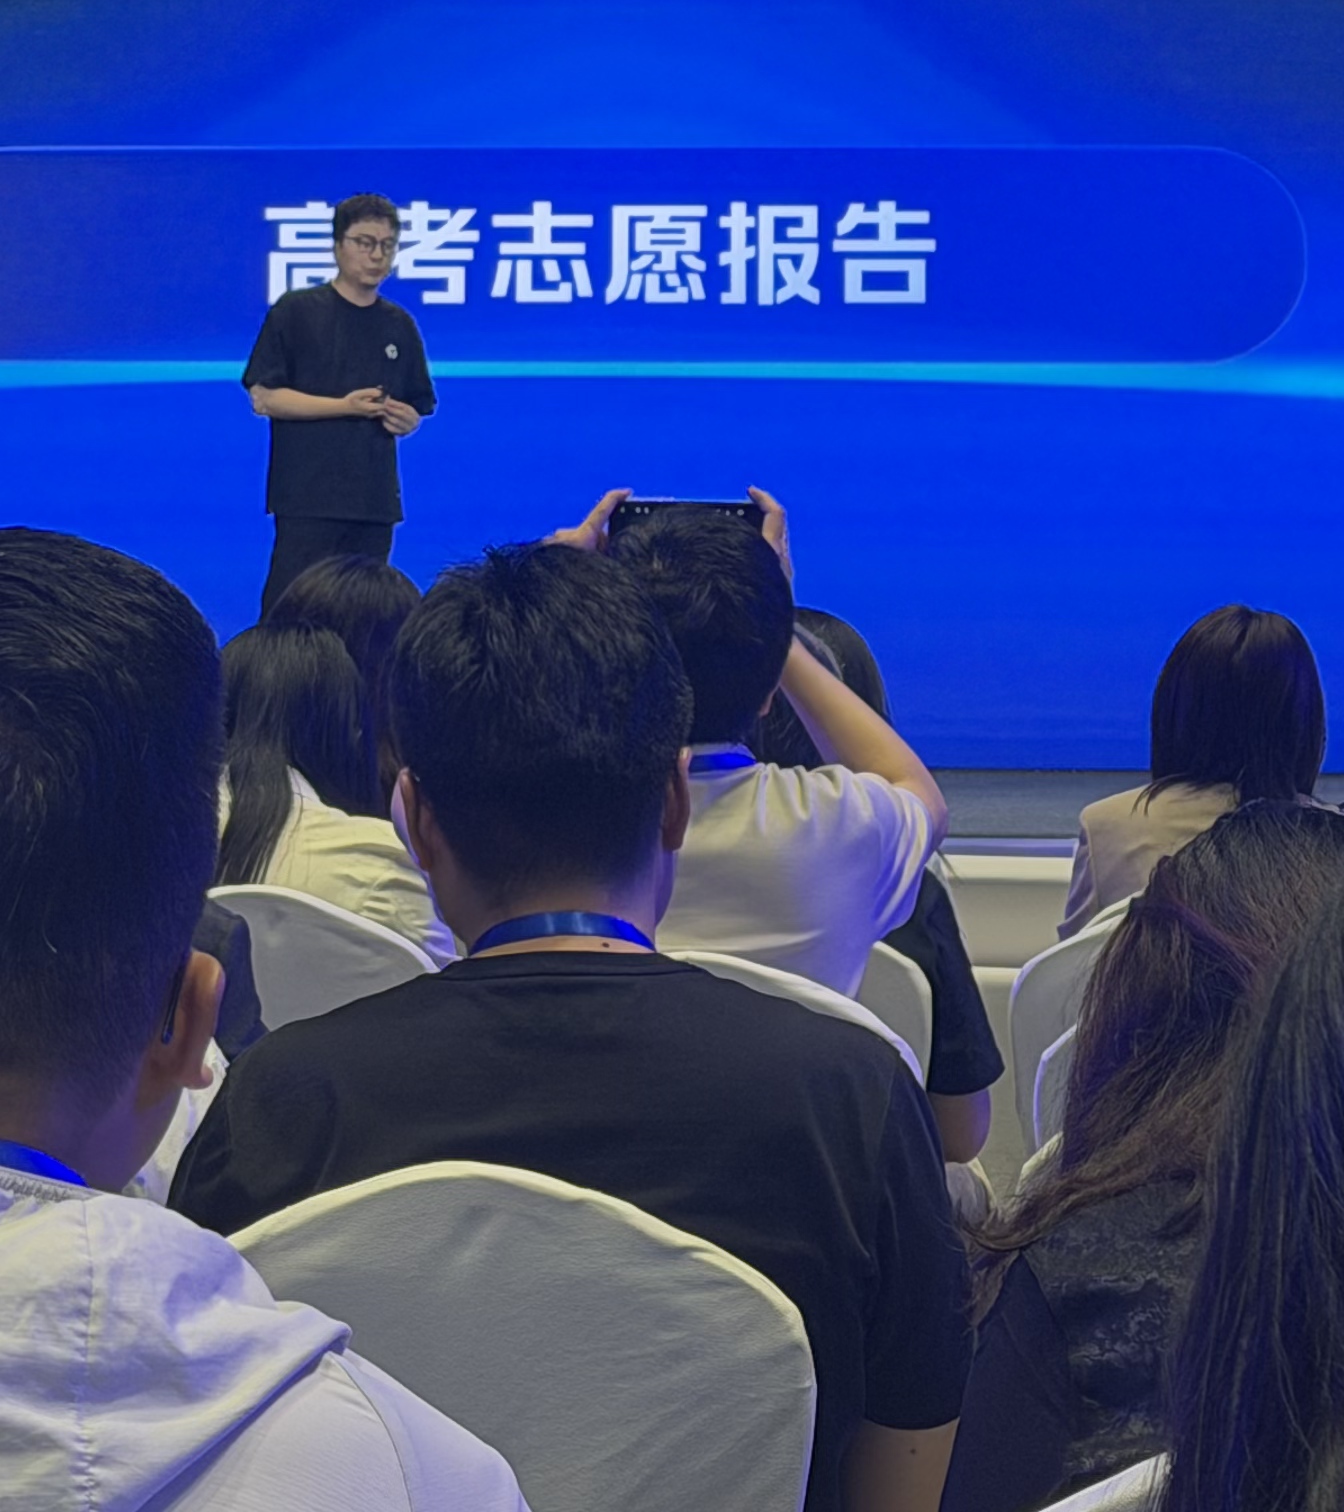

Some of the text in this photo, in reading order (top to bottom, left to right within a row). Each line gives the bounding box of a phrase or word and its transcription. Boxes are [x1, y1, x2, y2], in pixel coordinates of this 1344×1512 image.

[264, 200, 936, 305] 高考志愿报告
